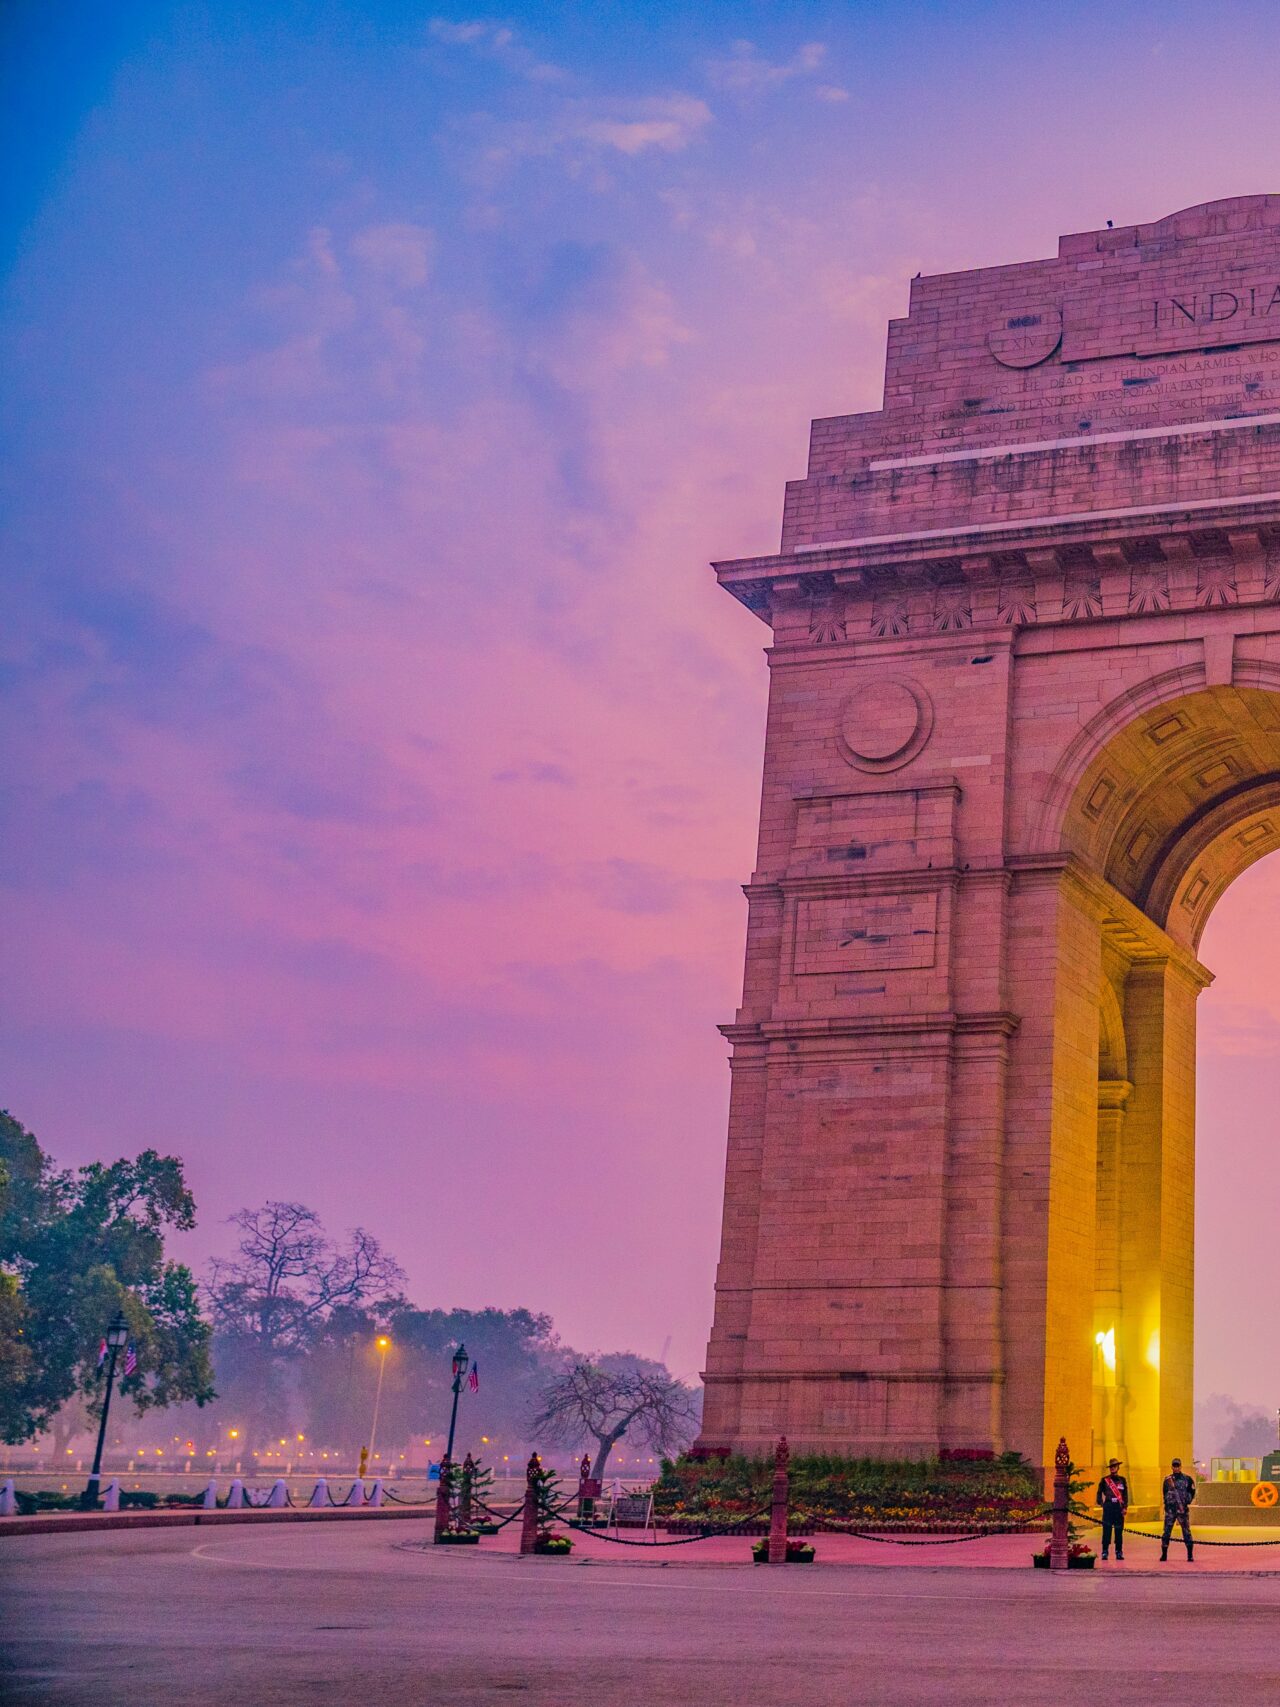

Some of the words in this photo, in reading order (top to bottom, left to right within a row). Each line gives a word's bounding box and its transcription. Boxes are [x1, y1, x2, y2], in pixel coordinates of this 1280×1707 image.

[1013, 336, 1038, 350] XIV
[990, 401, 1015, 413] AND
[1022, 393, 1084, 411] FLANDERS
[1091, 381, 1177, 402] MESOPOTAMIA
[1184, 377, 1214, 392] AND
[1222, 370, 1264, 387] PERSIA
[992, 386, 1009, 395] TO
[1015, 379, 1040, 392] THE
[1050, 375, 1084, 389] DEAD
[1090, 372, 1105, 384] OF
[1112, 368, 1138, 382] THE
[1143, 362, 1188, 378] INDIAN
[1195, 355, 1241, 371] ARMIES
[1247, 350, 1279, 365] WHO
[932, 426, 964, 441] NEAR
[976, 421, 1001, 435] AND
[1008, 417, 1032, 431] THE
[1041, 413, 1063, 427] FAR
[1073, 407, 1100, 424] EAST
[1111, 404, 1138, 419] AND
[1147, 402, 1160, 414] IN
[1170, 395, 1216, 411] SACRED
[1223, 388, 1277, 405] MEMORY
